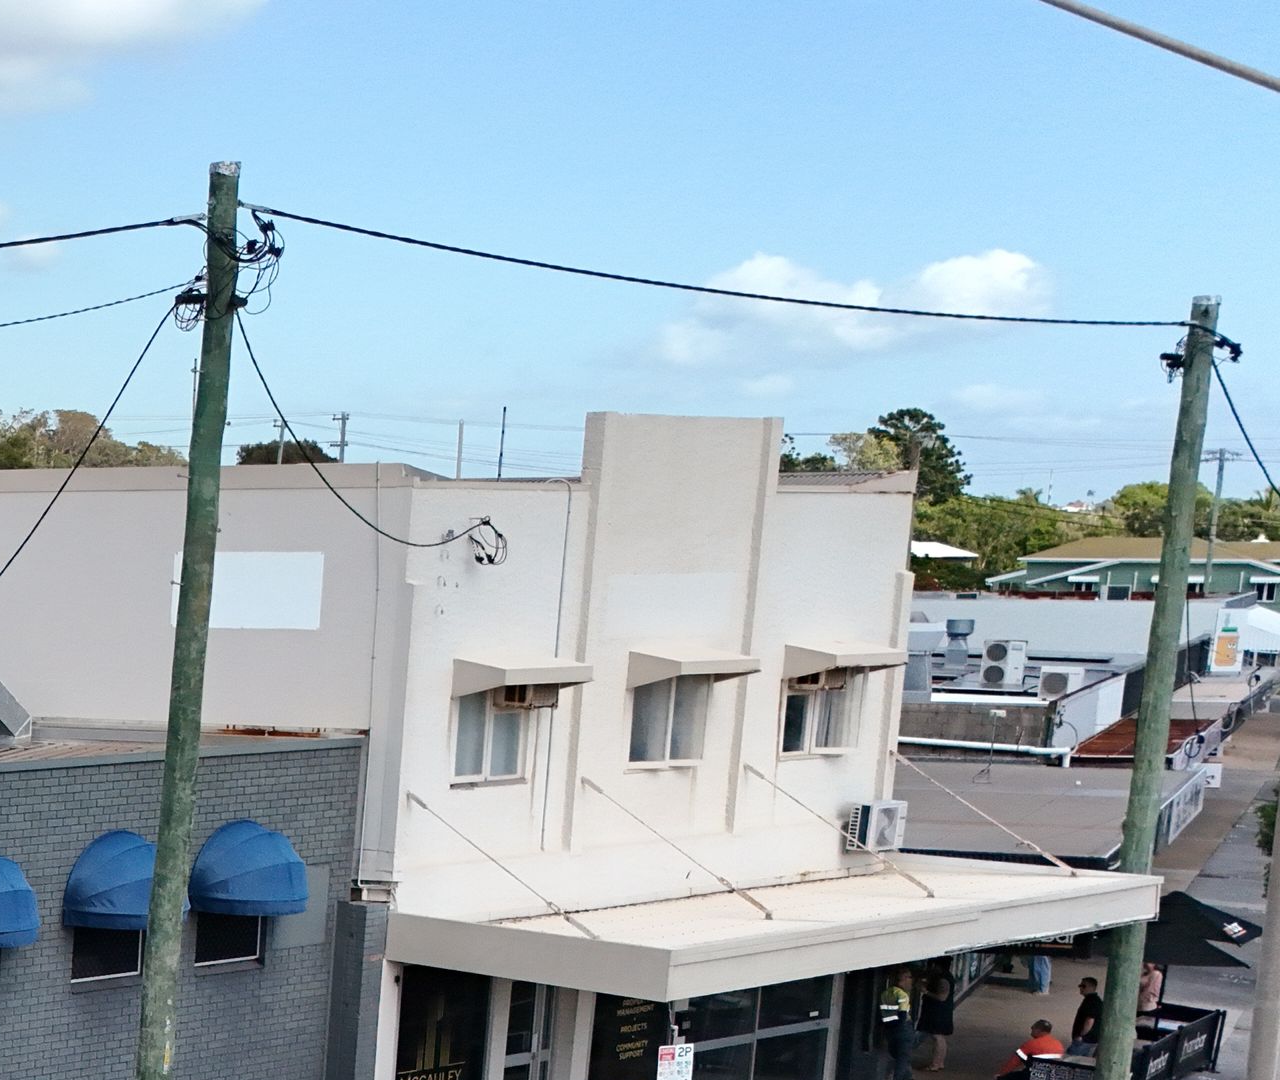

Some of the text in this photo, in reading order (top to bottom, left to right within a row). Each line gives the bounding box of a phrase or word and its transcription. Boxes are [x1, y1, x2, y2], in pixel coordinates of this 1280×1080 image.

[620, 1022, 648, 1032] PROJECTS
[616, 1040, 648, 1052] COMMUNITY
[620, 1050, 644, 1060] SUPPORT
[678, 1047, 692, 1058] 2P
